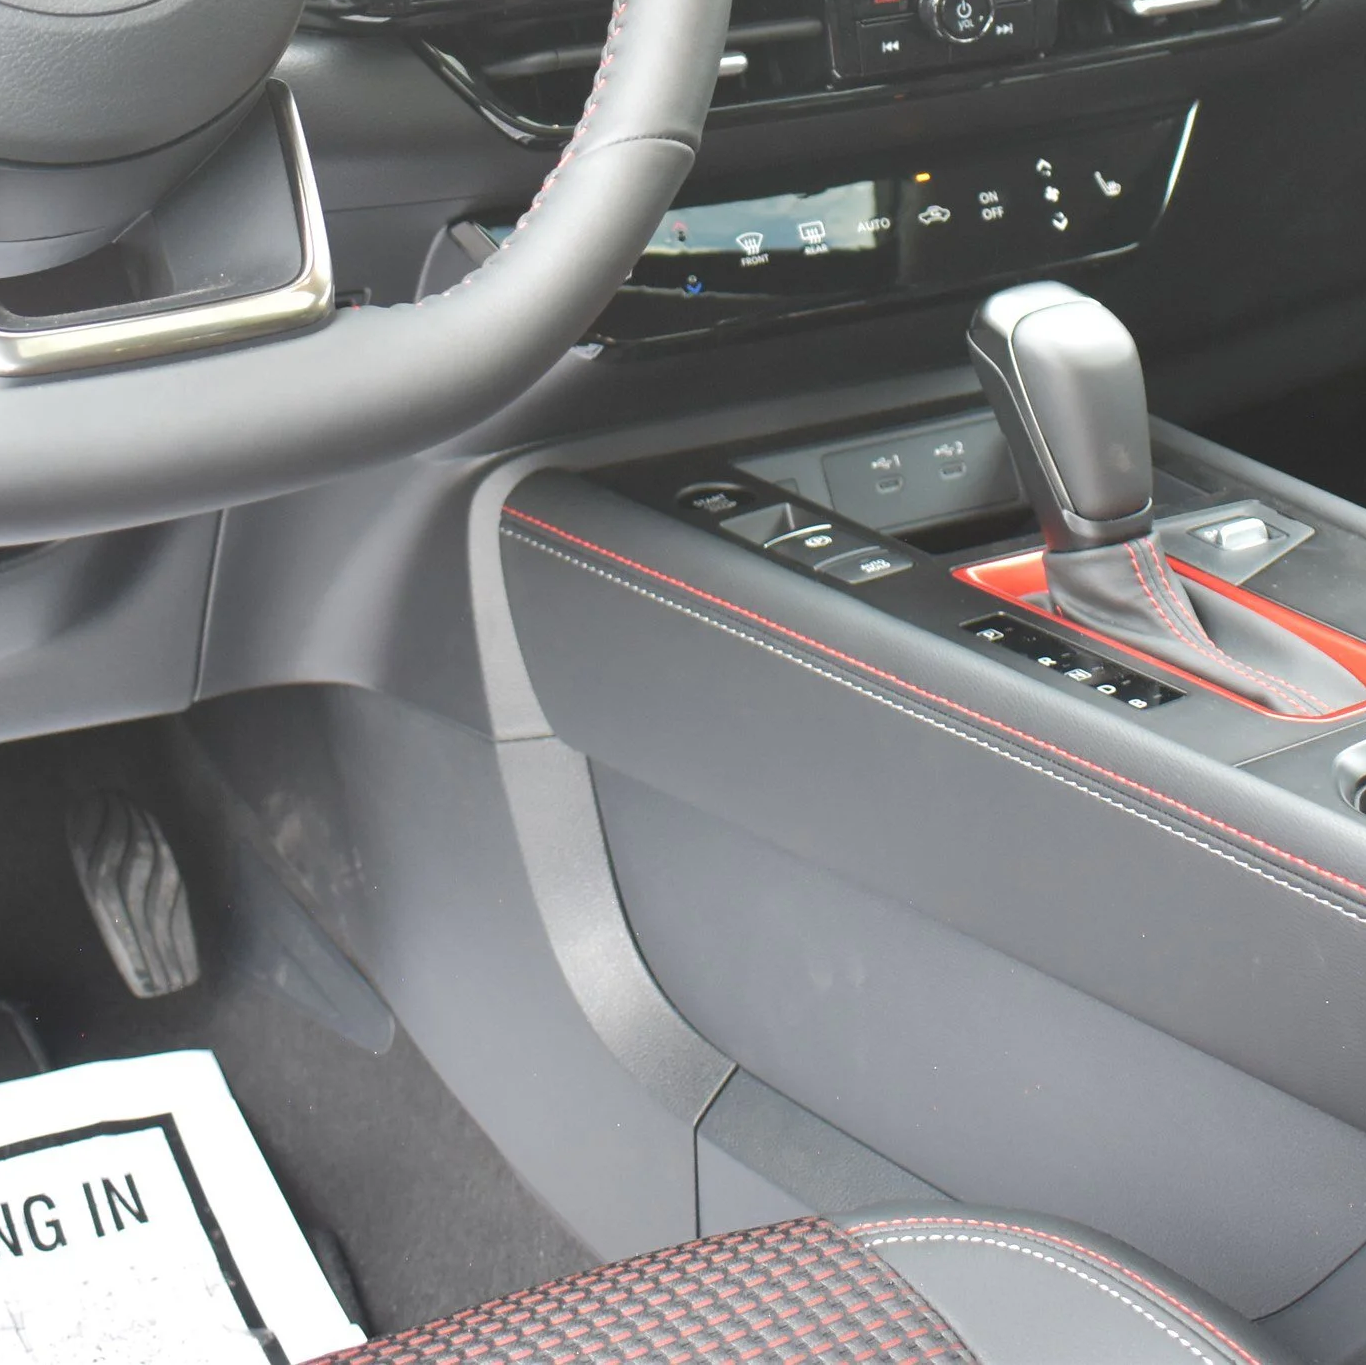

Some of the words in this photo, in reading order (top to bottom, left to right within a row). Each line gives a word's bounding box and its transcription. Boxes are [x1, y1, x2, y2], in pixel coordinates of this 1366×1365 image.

[957, 19, 975, 31] VOL
[979, 191, 999, 204] ON
[982, 206, 1004, 220] OFF
[857, 218, 891, 233] AUTO
[740, 253, 770, 267] FRONT
[1037, 657, 1057, 667] R
[1097, 684, 1117, 695] D
[82, 1172, 149, 1238] IN
